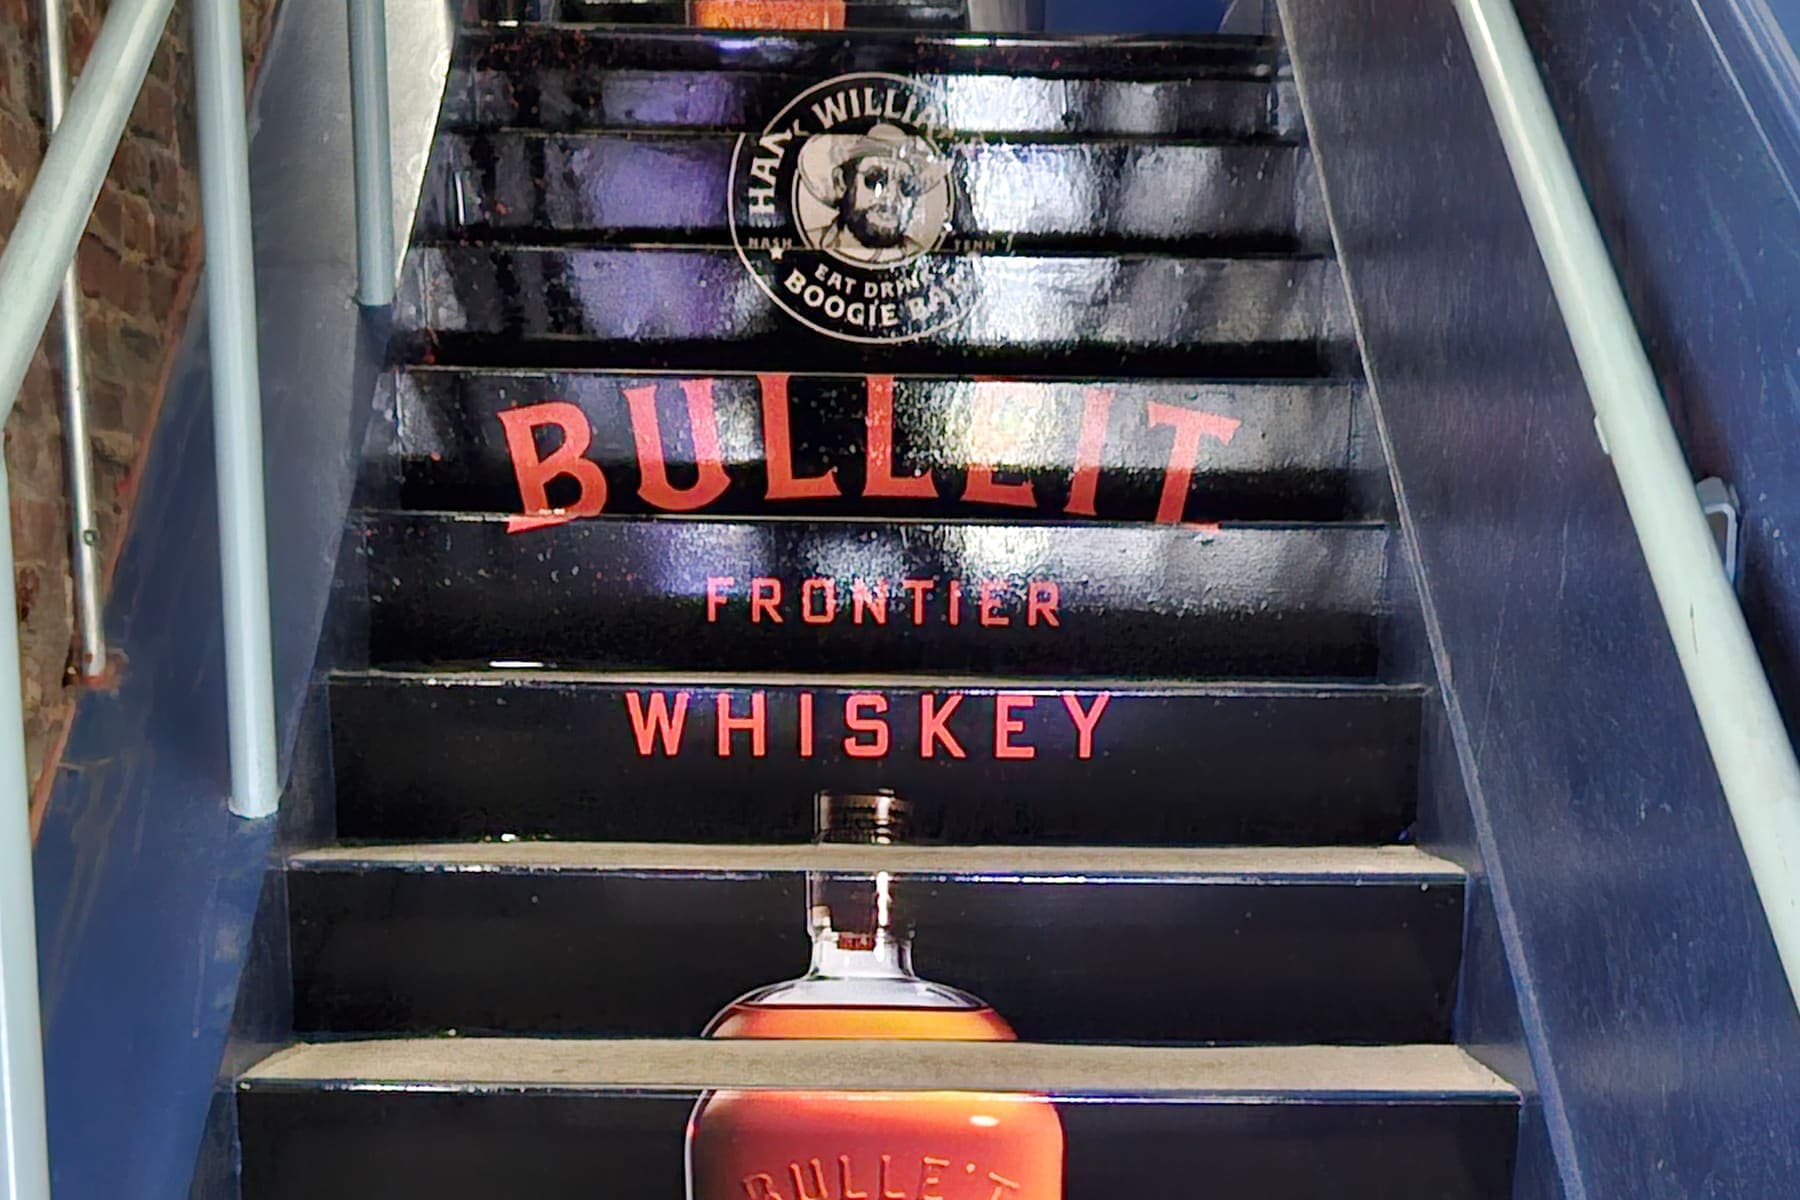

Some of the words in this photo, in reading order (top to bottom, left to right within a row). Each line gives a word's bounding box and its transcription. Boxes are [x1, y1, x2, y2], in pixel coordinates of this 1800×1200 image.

[784, 268, 898, 327] BOOGIE
[815, 263, 857, 296] EAT
[497, 374, 1242, 533] BULLEIT
[708, 576, 1061, 628] FRONTIER
[625, 690, 1111, 758] WHISKEY
